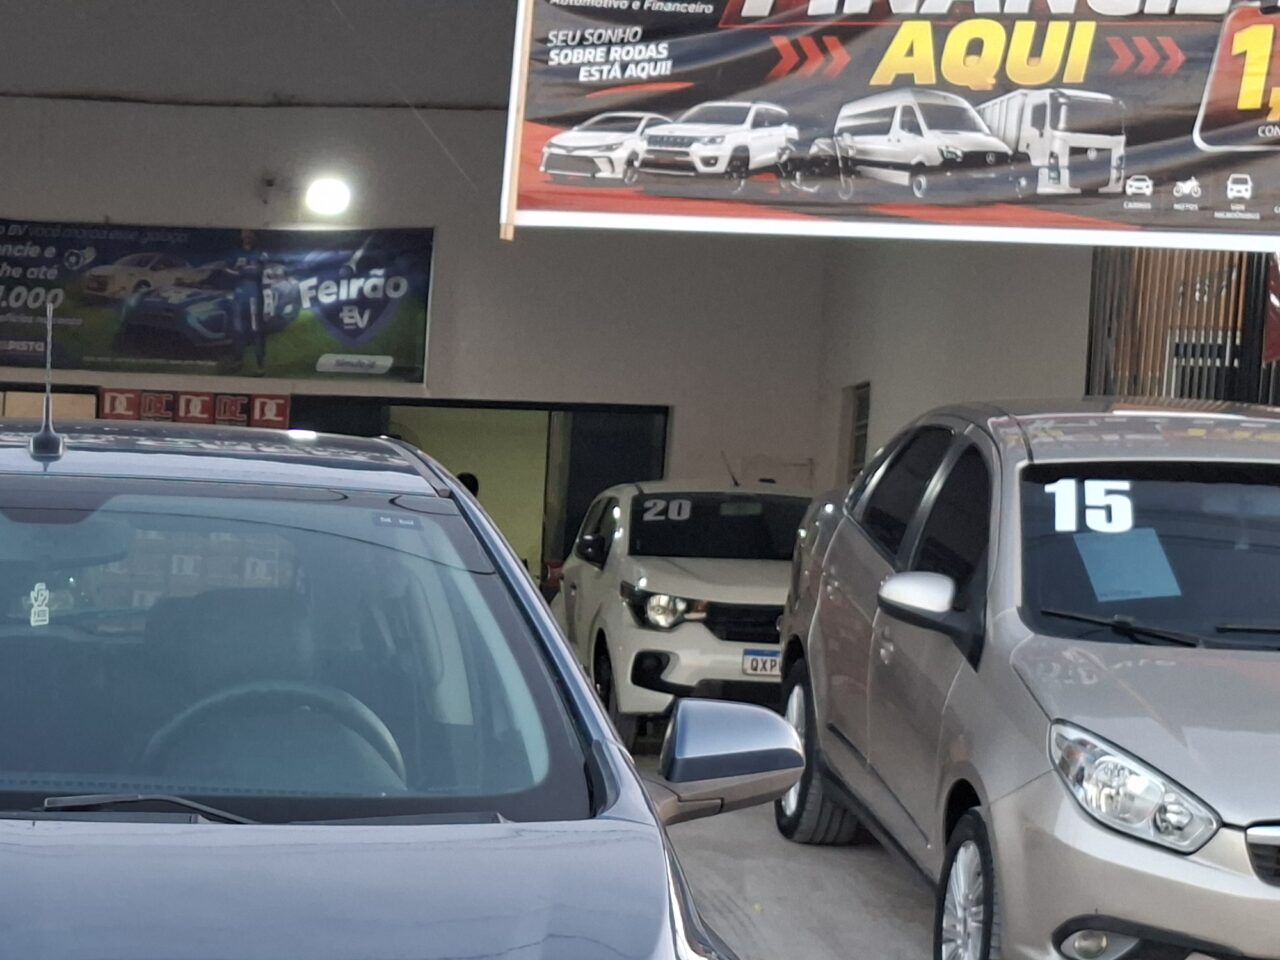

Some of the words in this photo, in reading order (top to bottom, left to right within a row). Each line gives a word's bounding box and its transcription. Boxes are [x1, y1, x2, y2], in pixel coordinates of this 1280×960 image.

[643, 0, 714, 14] Financeiro
[547, 29, 581, 47] SEU
[583, 26, 643, 45] SONHO
[548, 46, 607, 66] SOBRE
[609, 43, 669, 61] RODAS
[869, 18, 1097, 91] AQUI
[578, 61, 621, 81] ESTÁ
[623, 59, 673, 79] AQUI!
[7, 223, 29, 236] BV
[43, 246, 56, 258] e
[26, 263, 58, 280] até
[298, 268, 409, 309] Feirão
[642, 499, 692, 521] 20
[1044, 478, 1134, 533] 15
[750, 657, 781, 673] QXP
